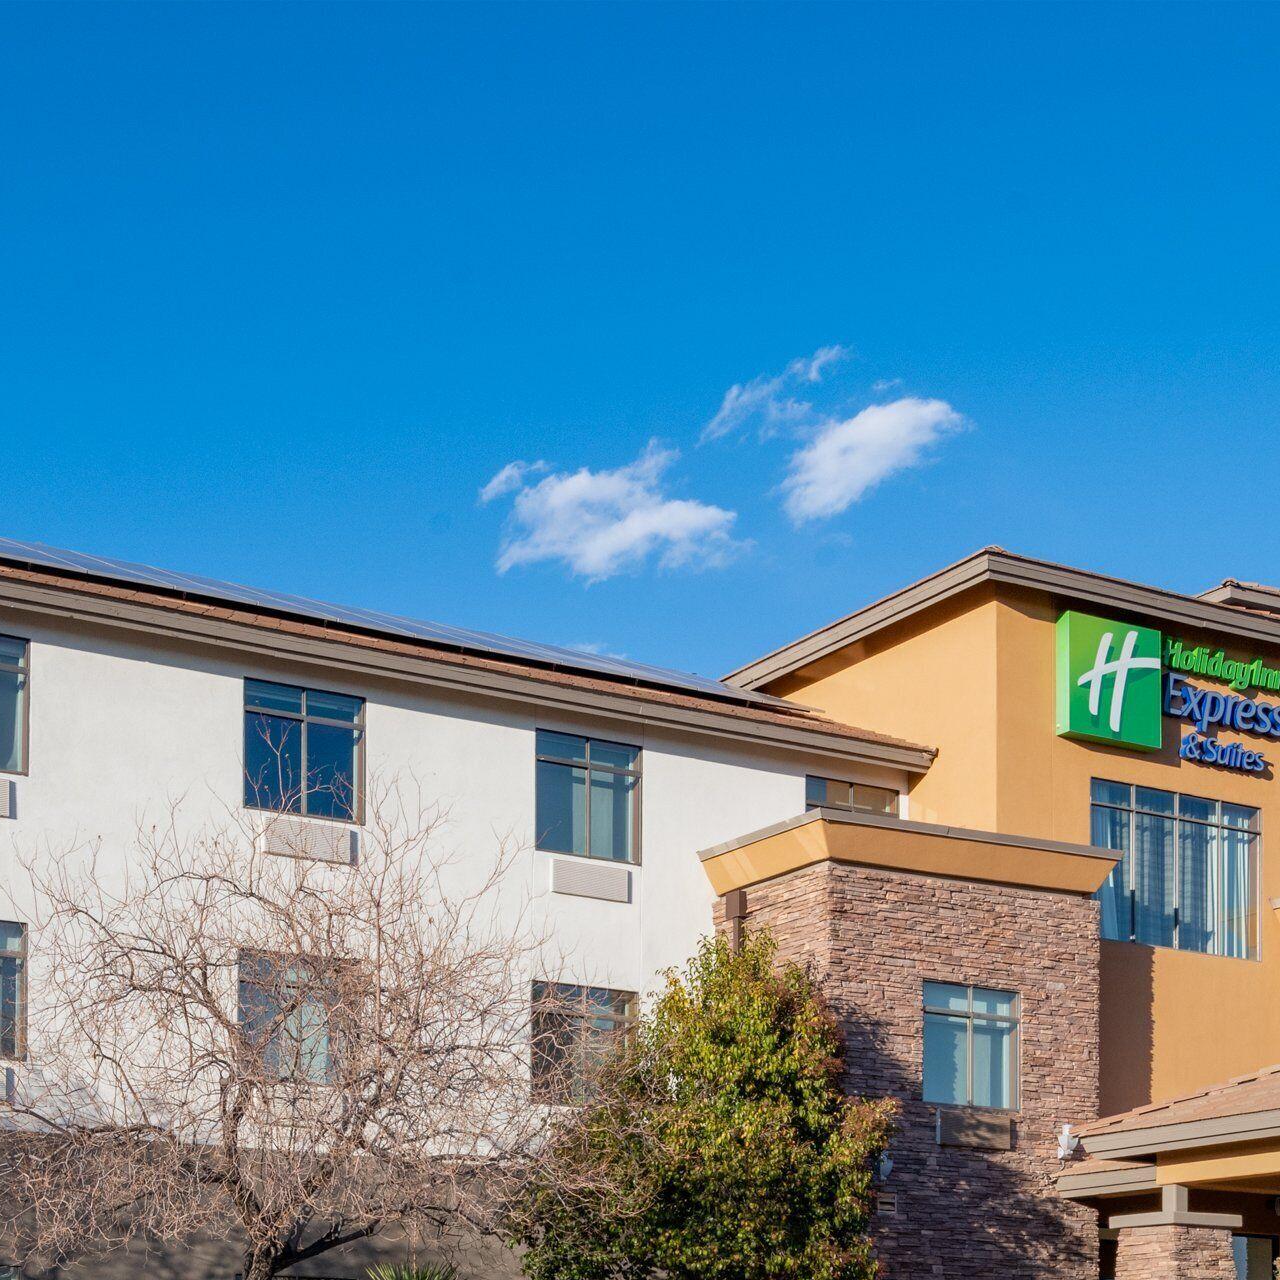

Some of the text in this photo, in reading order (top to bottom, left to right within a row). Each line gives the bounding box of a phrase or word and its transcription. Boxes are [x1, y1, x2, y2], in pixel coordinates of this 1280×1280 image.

[1166, 639, 1251, 691] Holiday
[1181, 733, 1265, 772] & Suites
